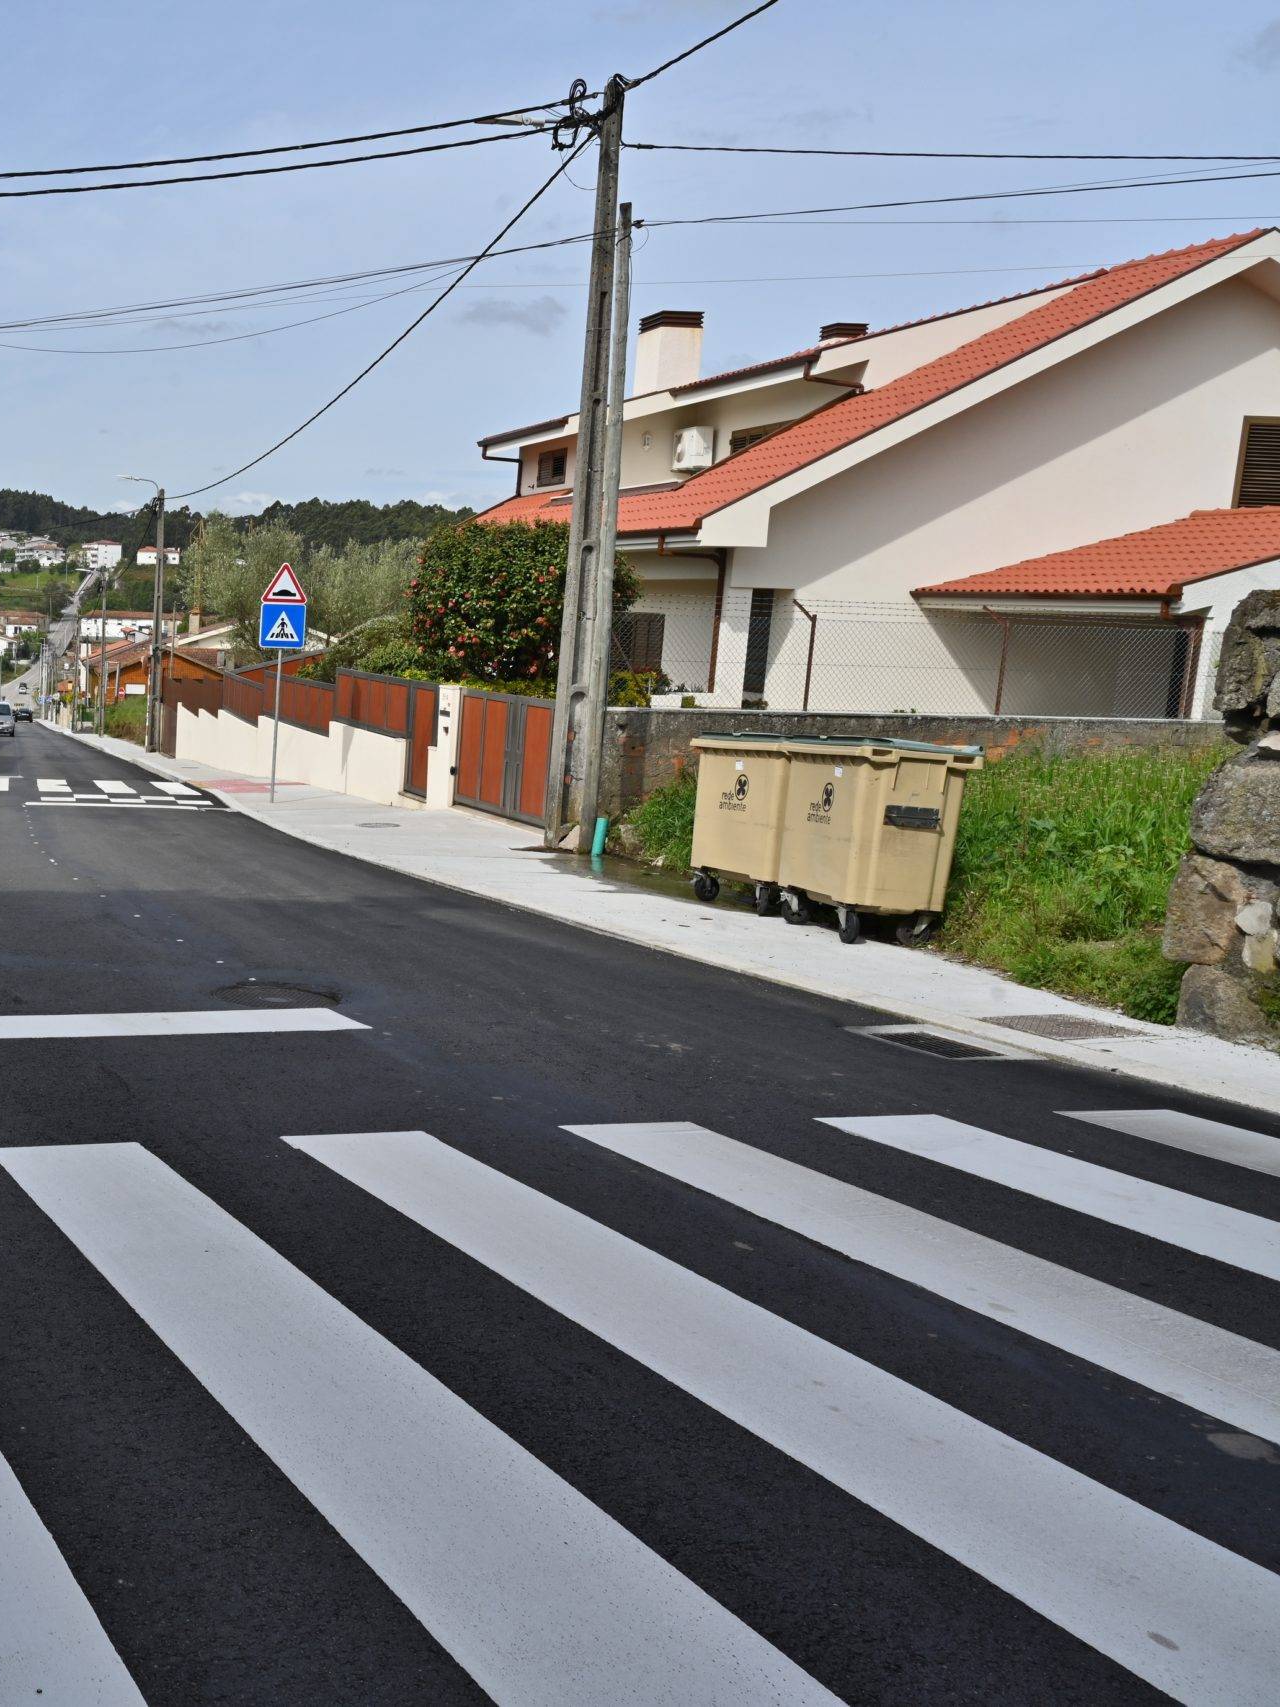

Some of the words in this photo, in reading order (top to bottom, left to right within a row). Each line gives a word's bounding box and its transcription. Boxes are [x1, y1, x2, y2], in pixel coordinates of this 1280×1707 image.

[722, 790, 734, 801] rede
[719, 801, 747, 812] ambiente
[810, 801, 821, 812] rede
[807, 812, 831, 824] ambiente
